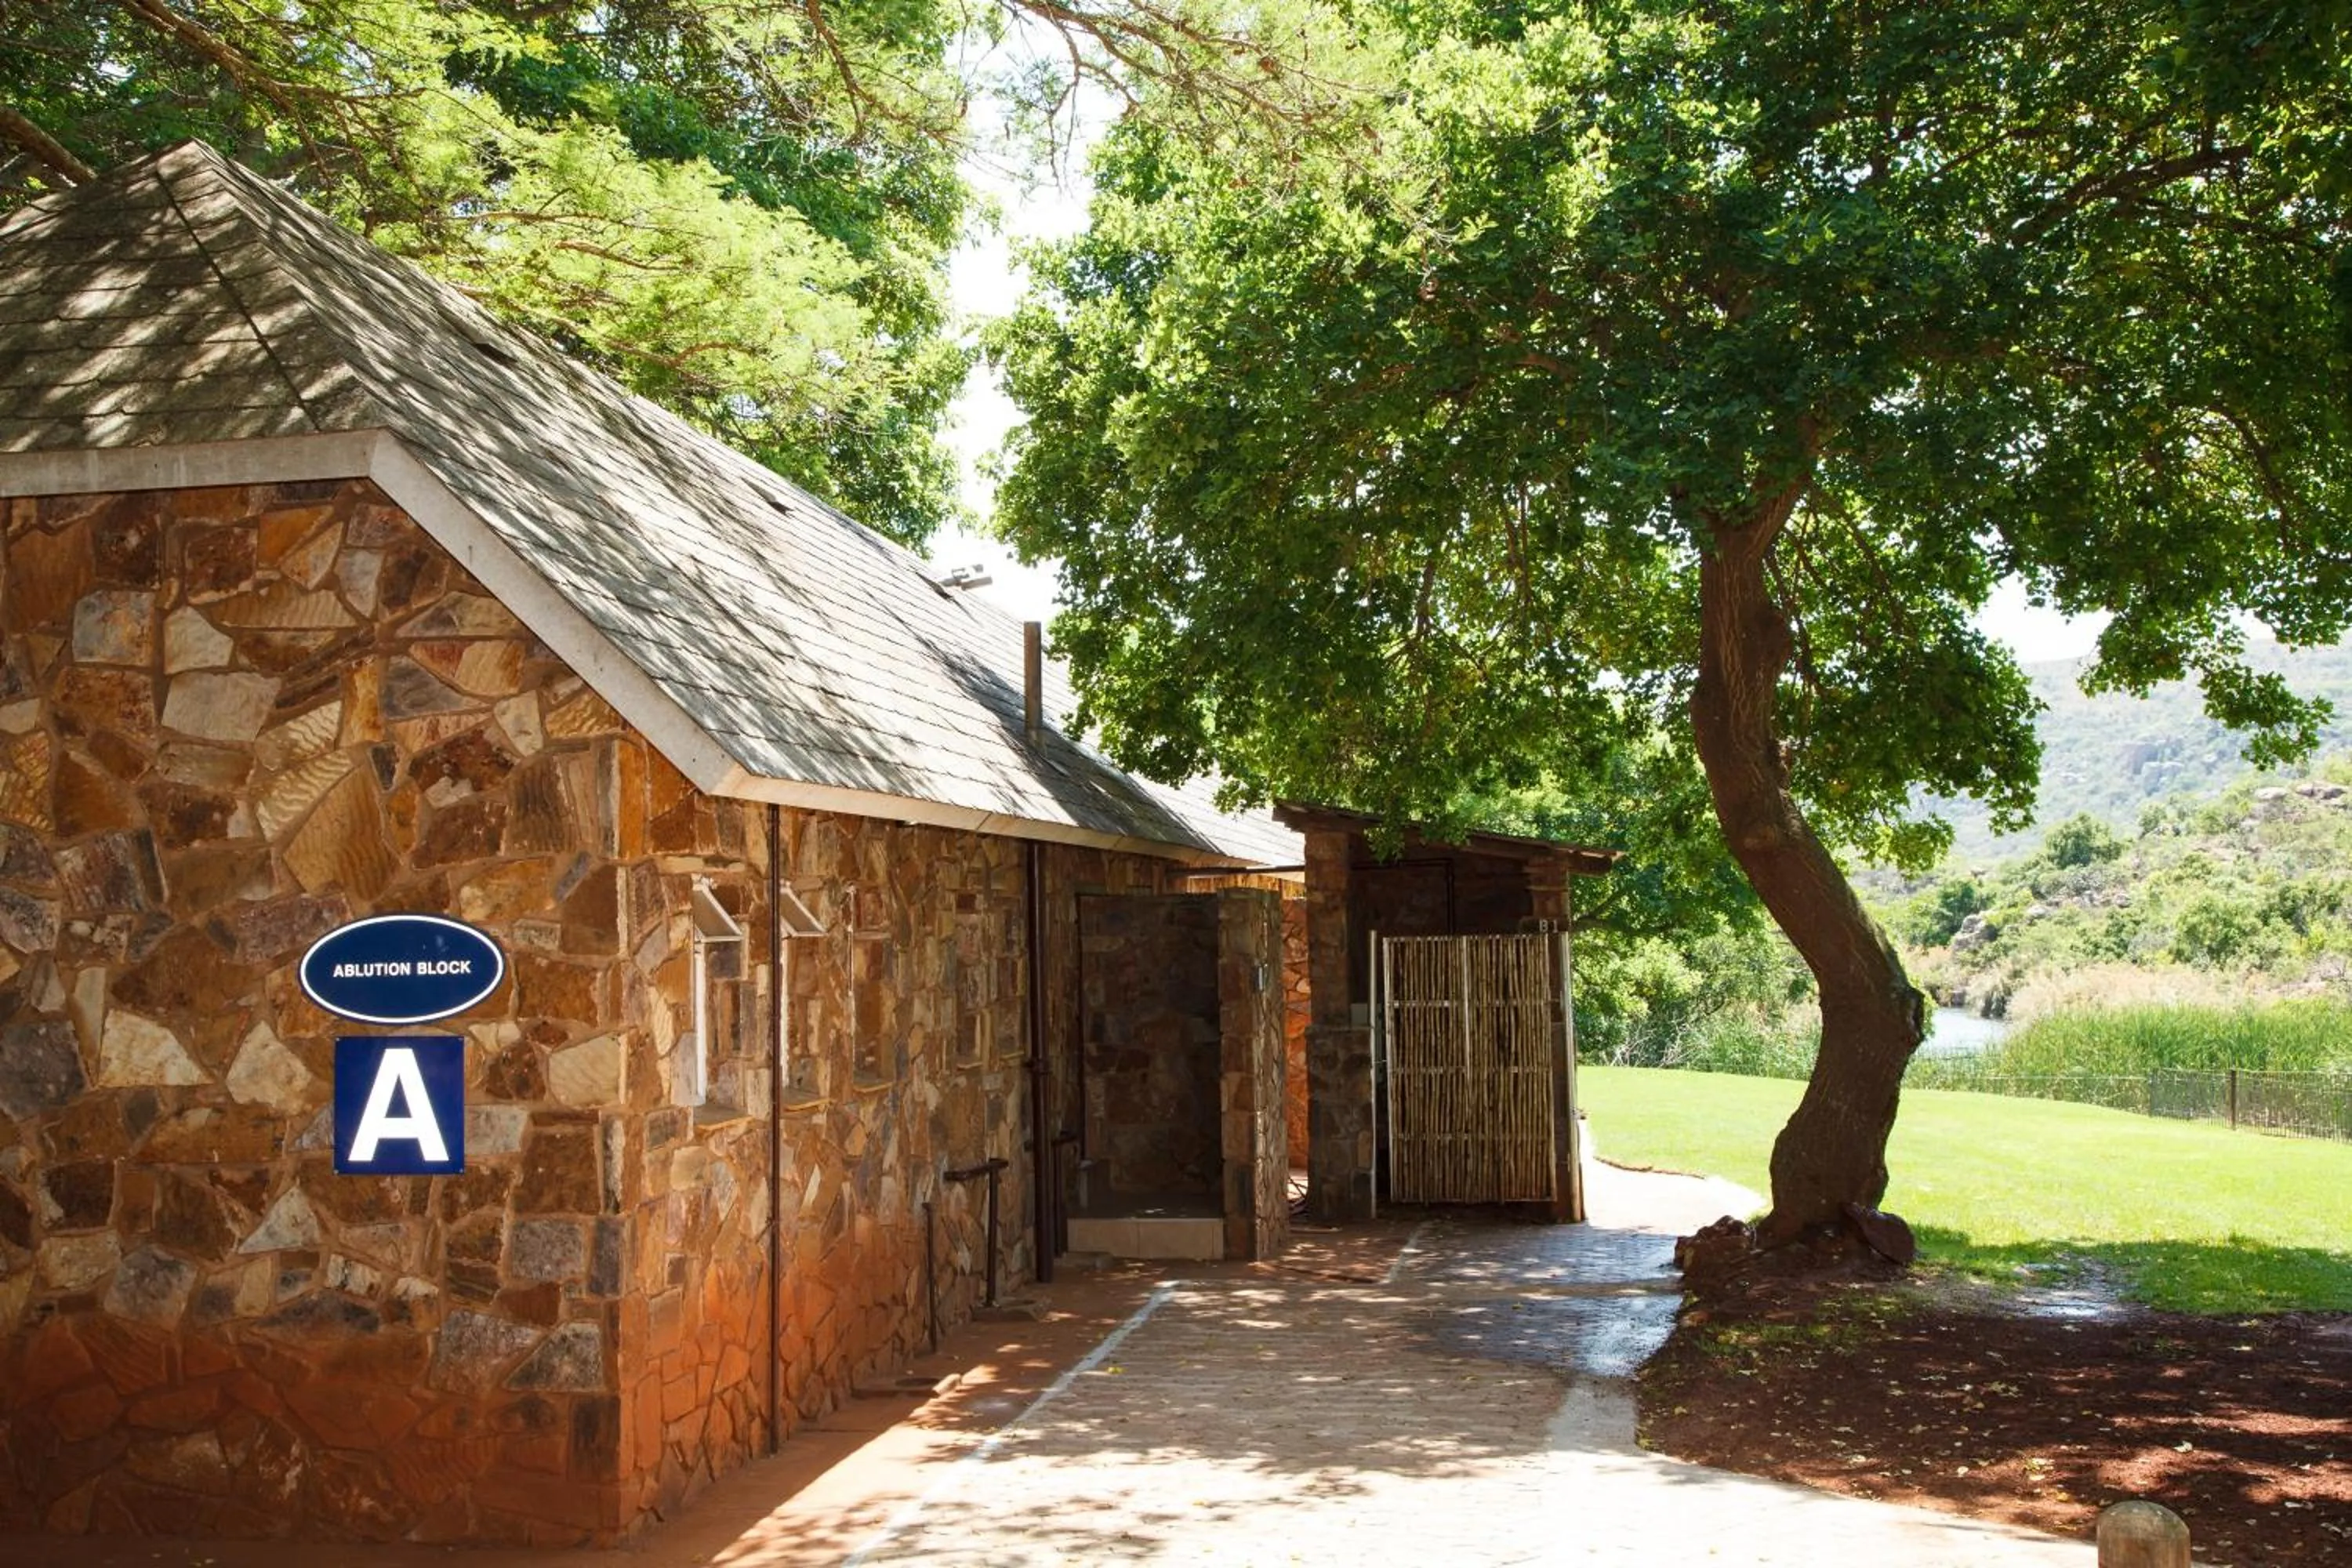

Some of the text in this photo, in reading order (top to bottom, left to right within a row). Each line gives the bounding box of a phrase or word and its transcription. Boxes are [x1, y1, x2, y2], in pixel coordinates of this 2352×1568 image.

[333, 960, 471, 978] ABLUTION BLOCK
[348, 1047, 449, 1162] A
